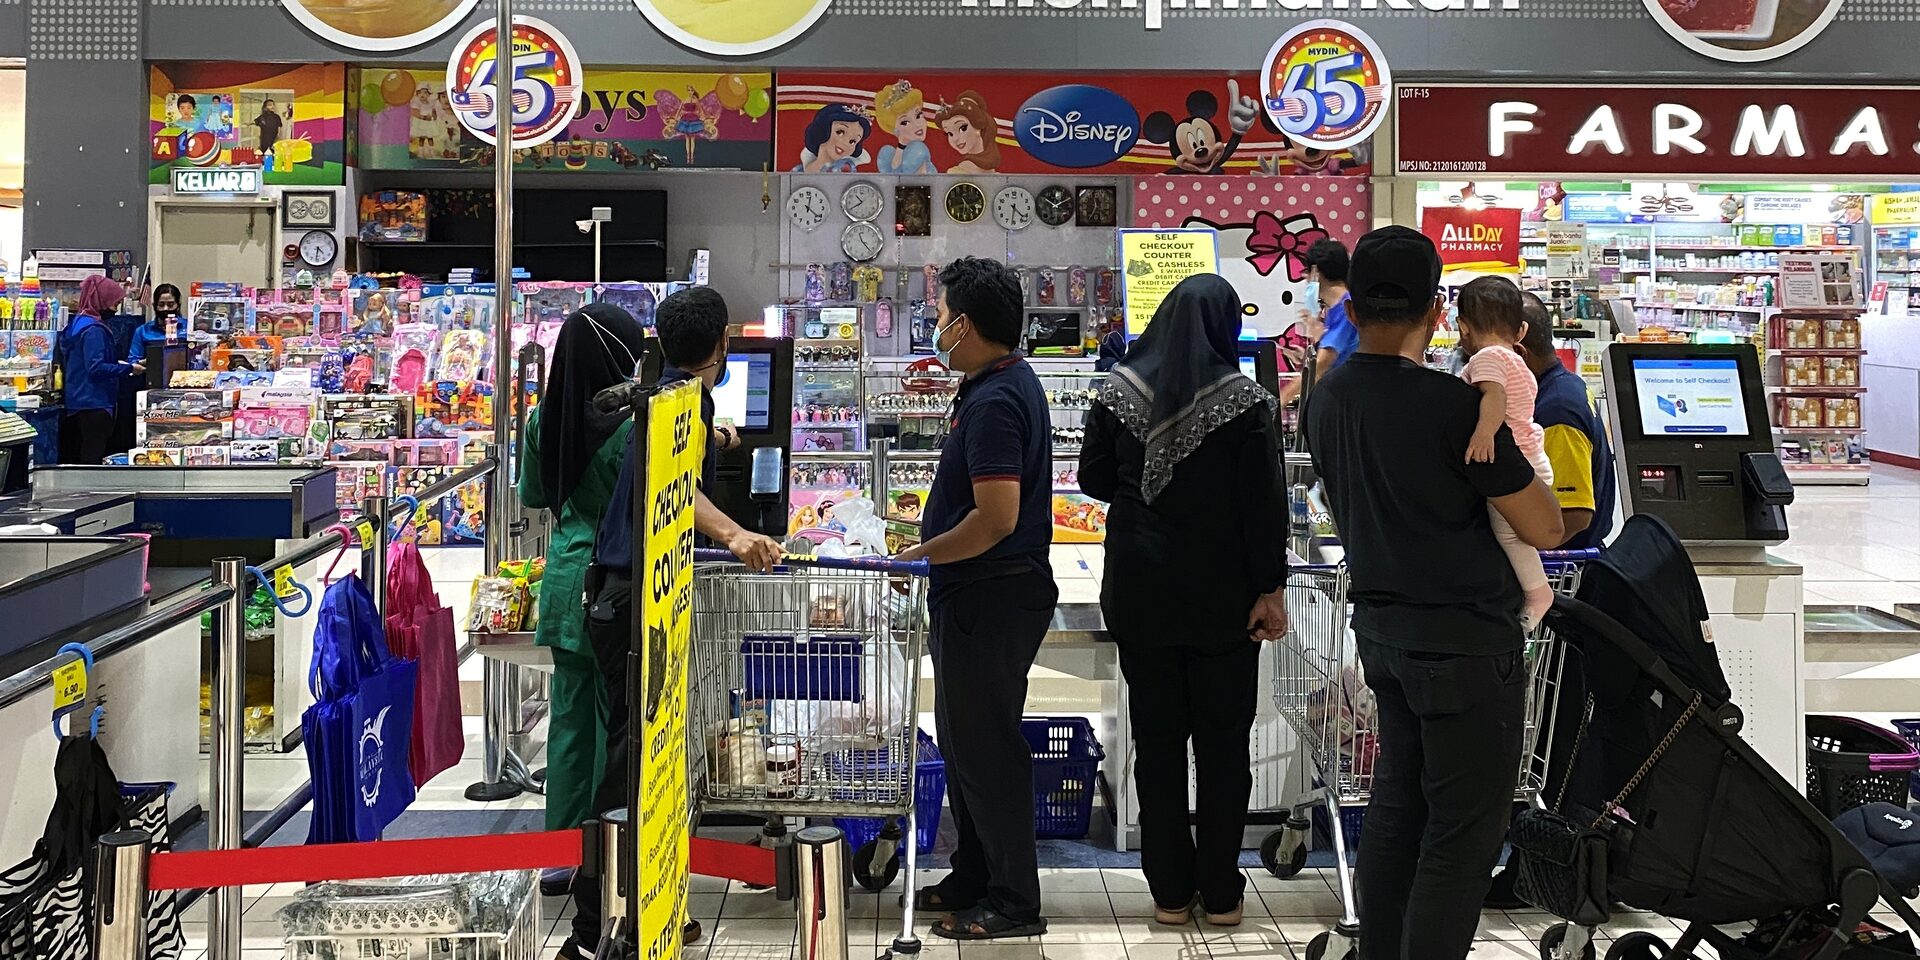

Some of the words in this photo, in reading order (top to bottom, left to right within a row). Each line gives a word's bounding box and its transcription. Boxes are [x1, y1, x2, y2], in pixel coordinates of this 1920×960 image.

[513, 44, 531, 52] DIN
[1308, 47, 1339, 56] MYDIN
[463, 51, 556, 131] 65
[1277, 52, 1366, 135] 65
[1400, 89, 1413, 98] LOT
[1414, 88, 1430, 98] F-15
[1488, 101, 1920, 157] FARMA
[1400, 161, 1418, 171] MPSJ
[1419, 161, 1432, 171] NO:
[1433, 161, 1487, 171] 2120161200128
[177, 172, 240, 191] KELUAR
[1441, 243, 1503, 251] PHARMACY
[64, 682, 79, 697] 6.90
